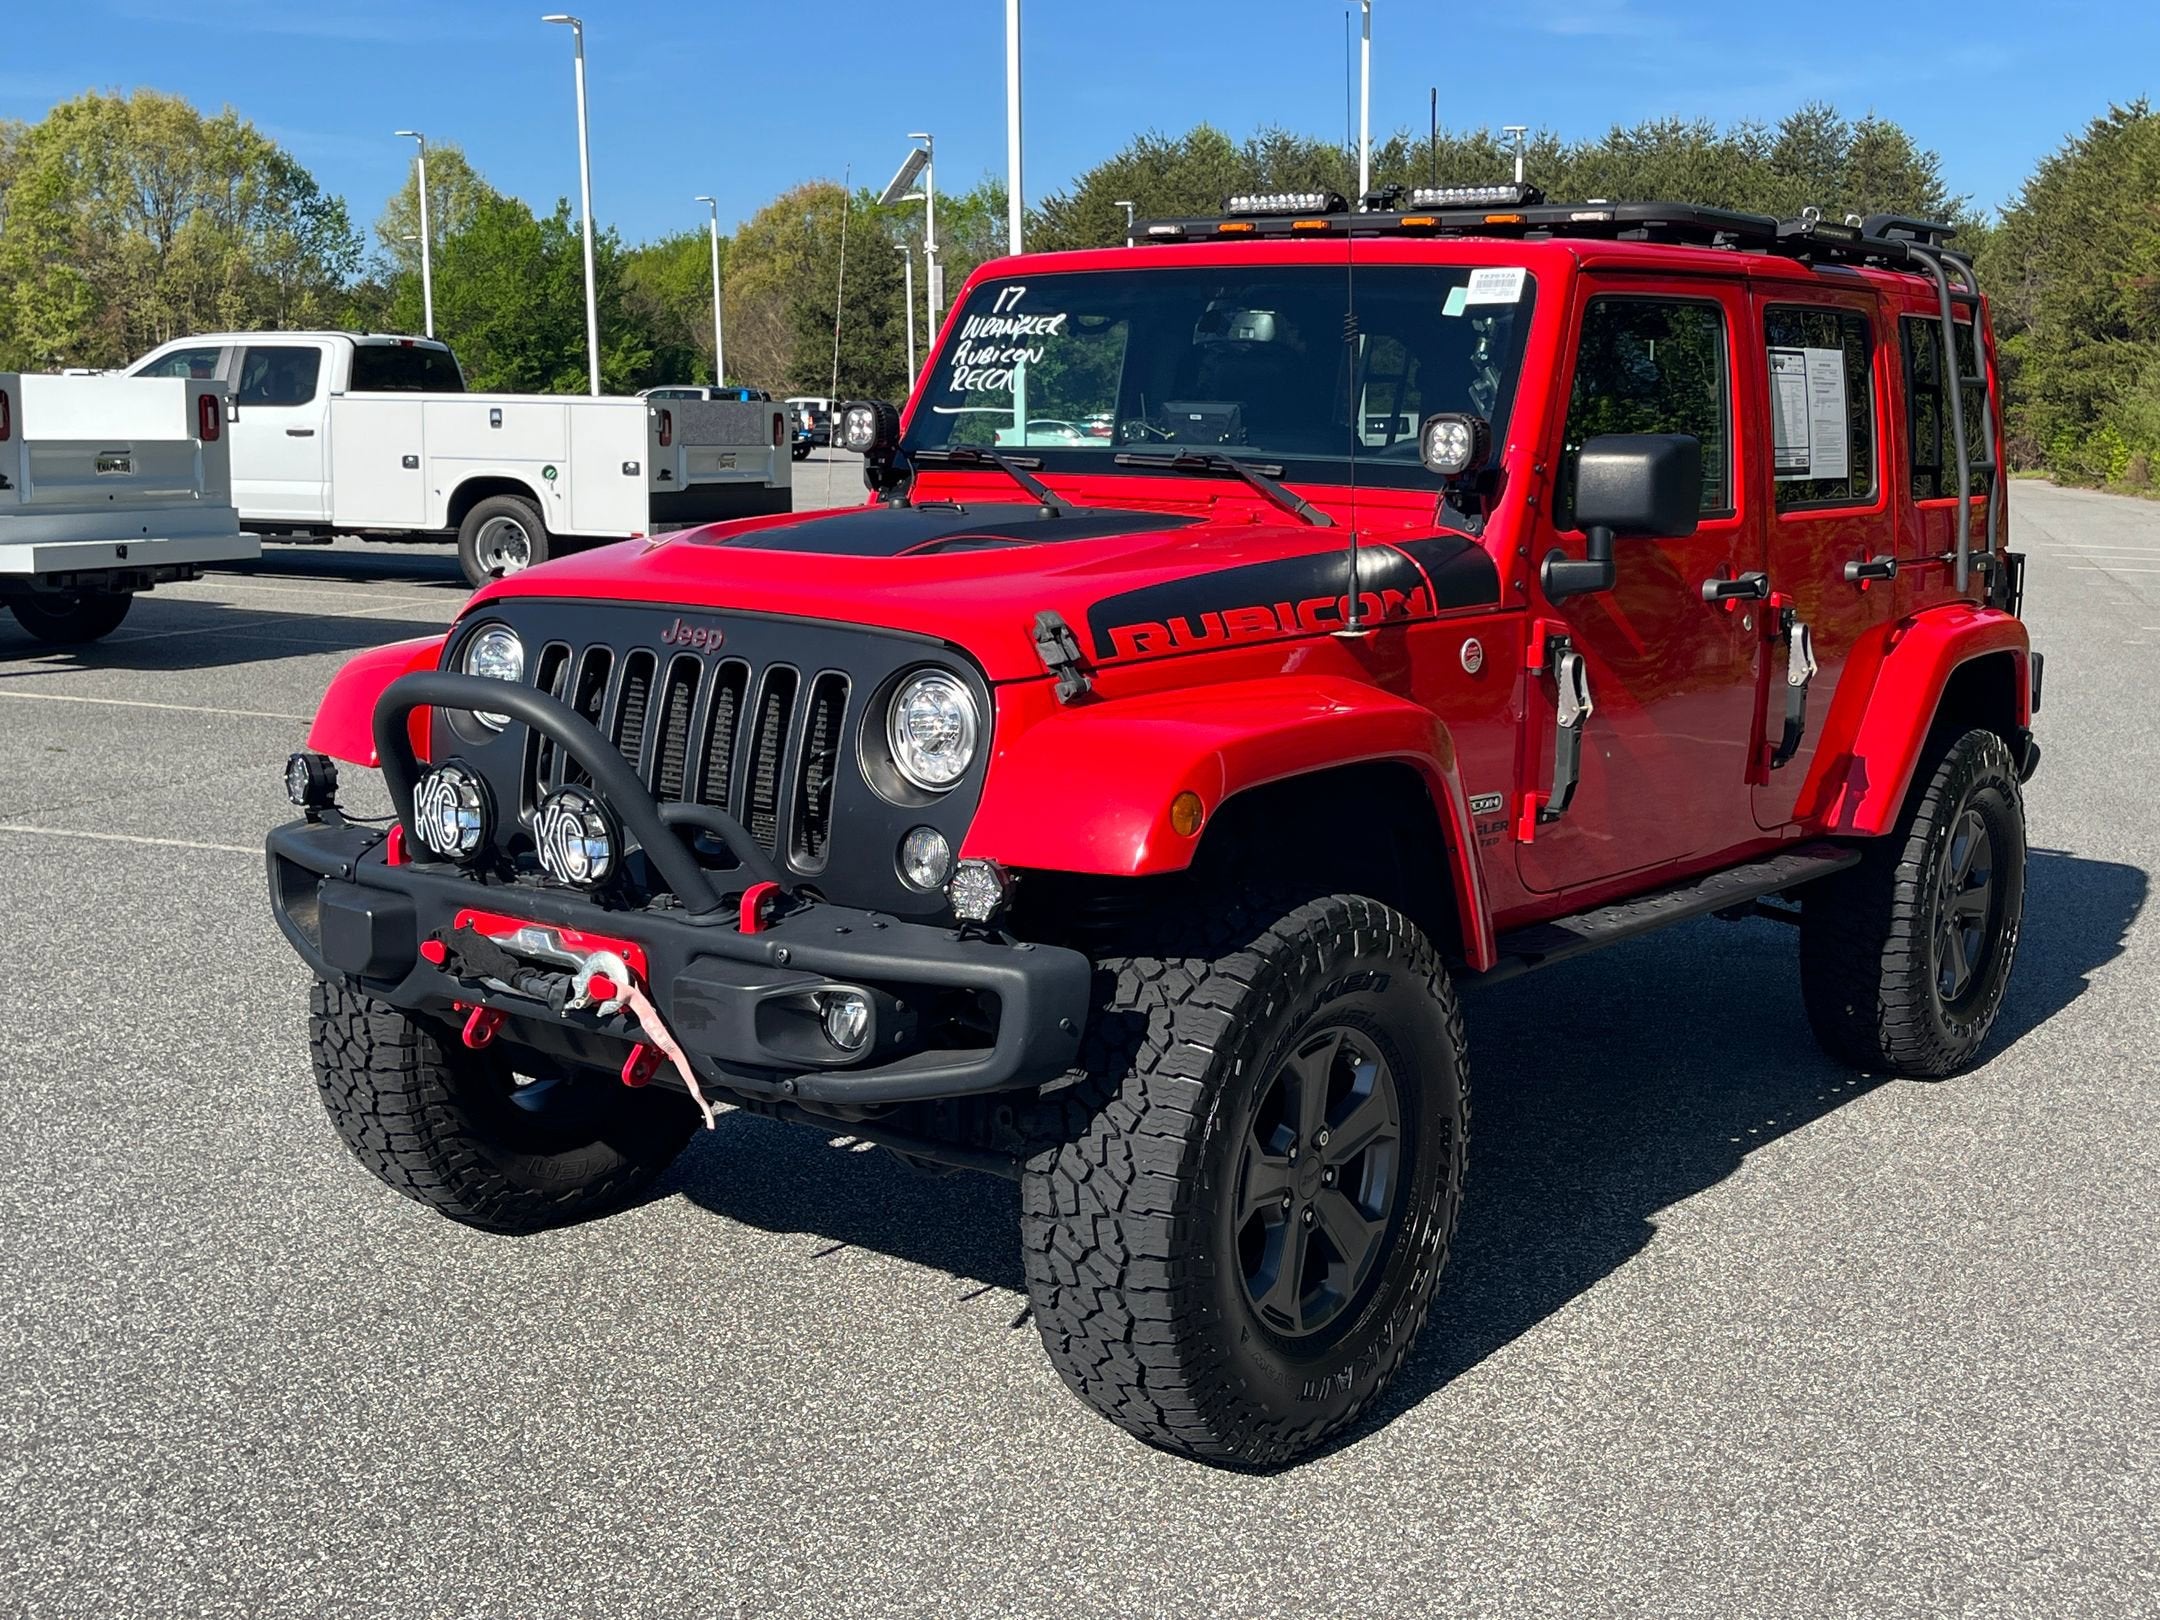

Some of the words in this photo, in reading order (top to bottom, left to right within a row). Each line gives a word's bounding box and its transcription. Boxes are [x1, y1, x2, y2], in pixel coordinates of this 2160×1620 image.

[992, 286, 1026, 313] 17
[949, 366, 1026, 394] RECON
[661, 617, 724, 656] Jeep
[1108, 585, 1432, 661] RUBICON
[413, 775, 460, 854] KC
[1477, 821, 1509, 835] GLER
[533, 804, 588, 884] KC
